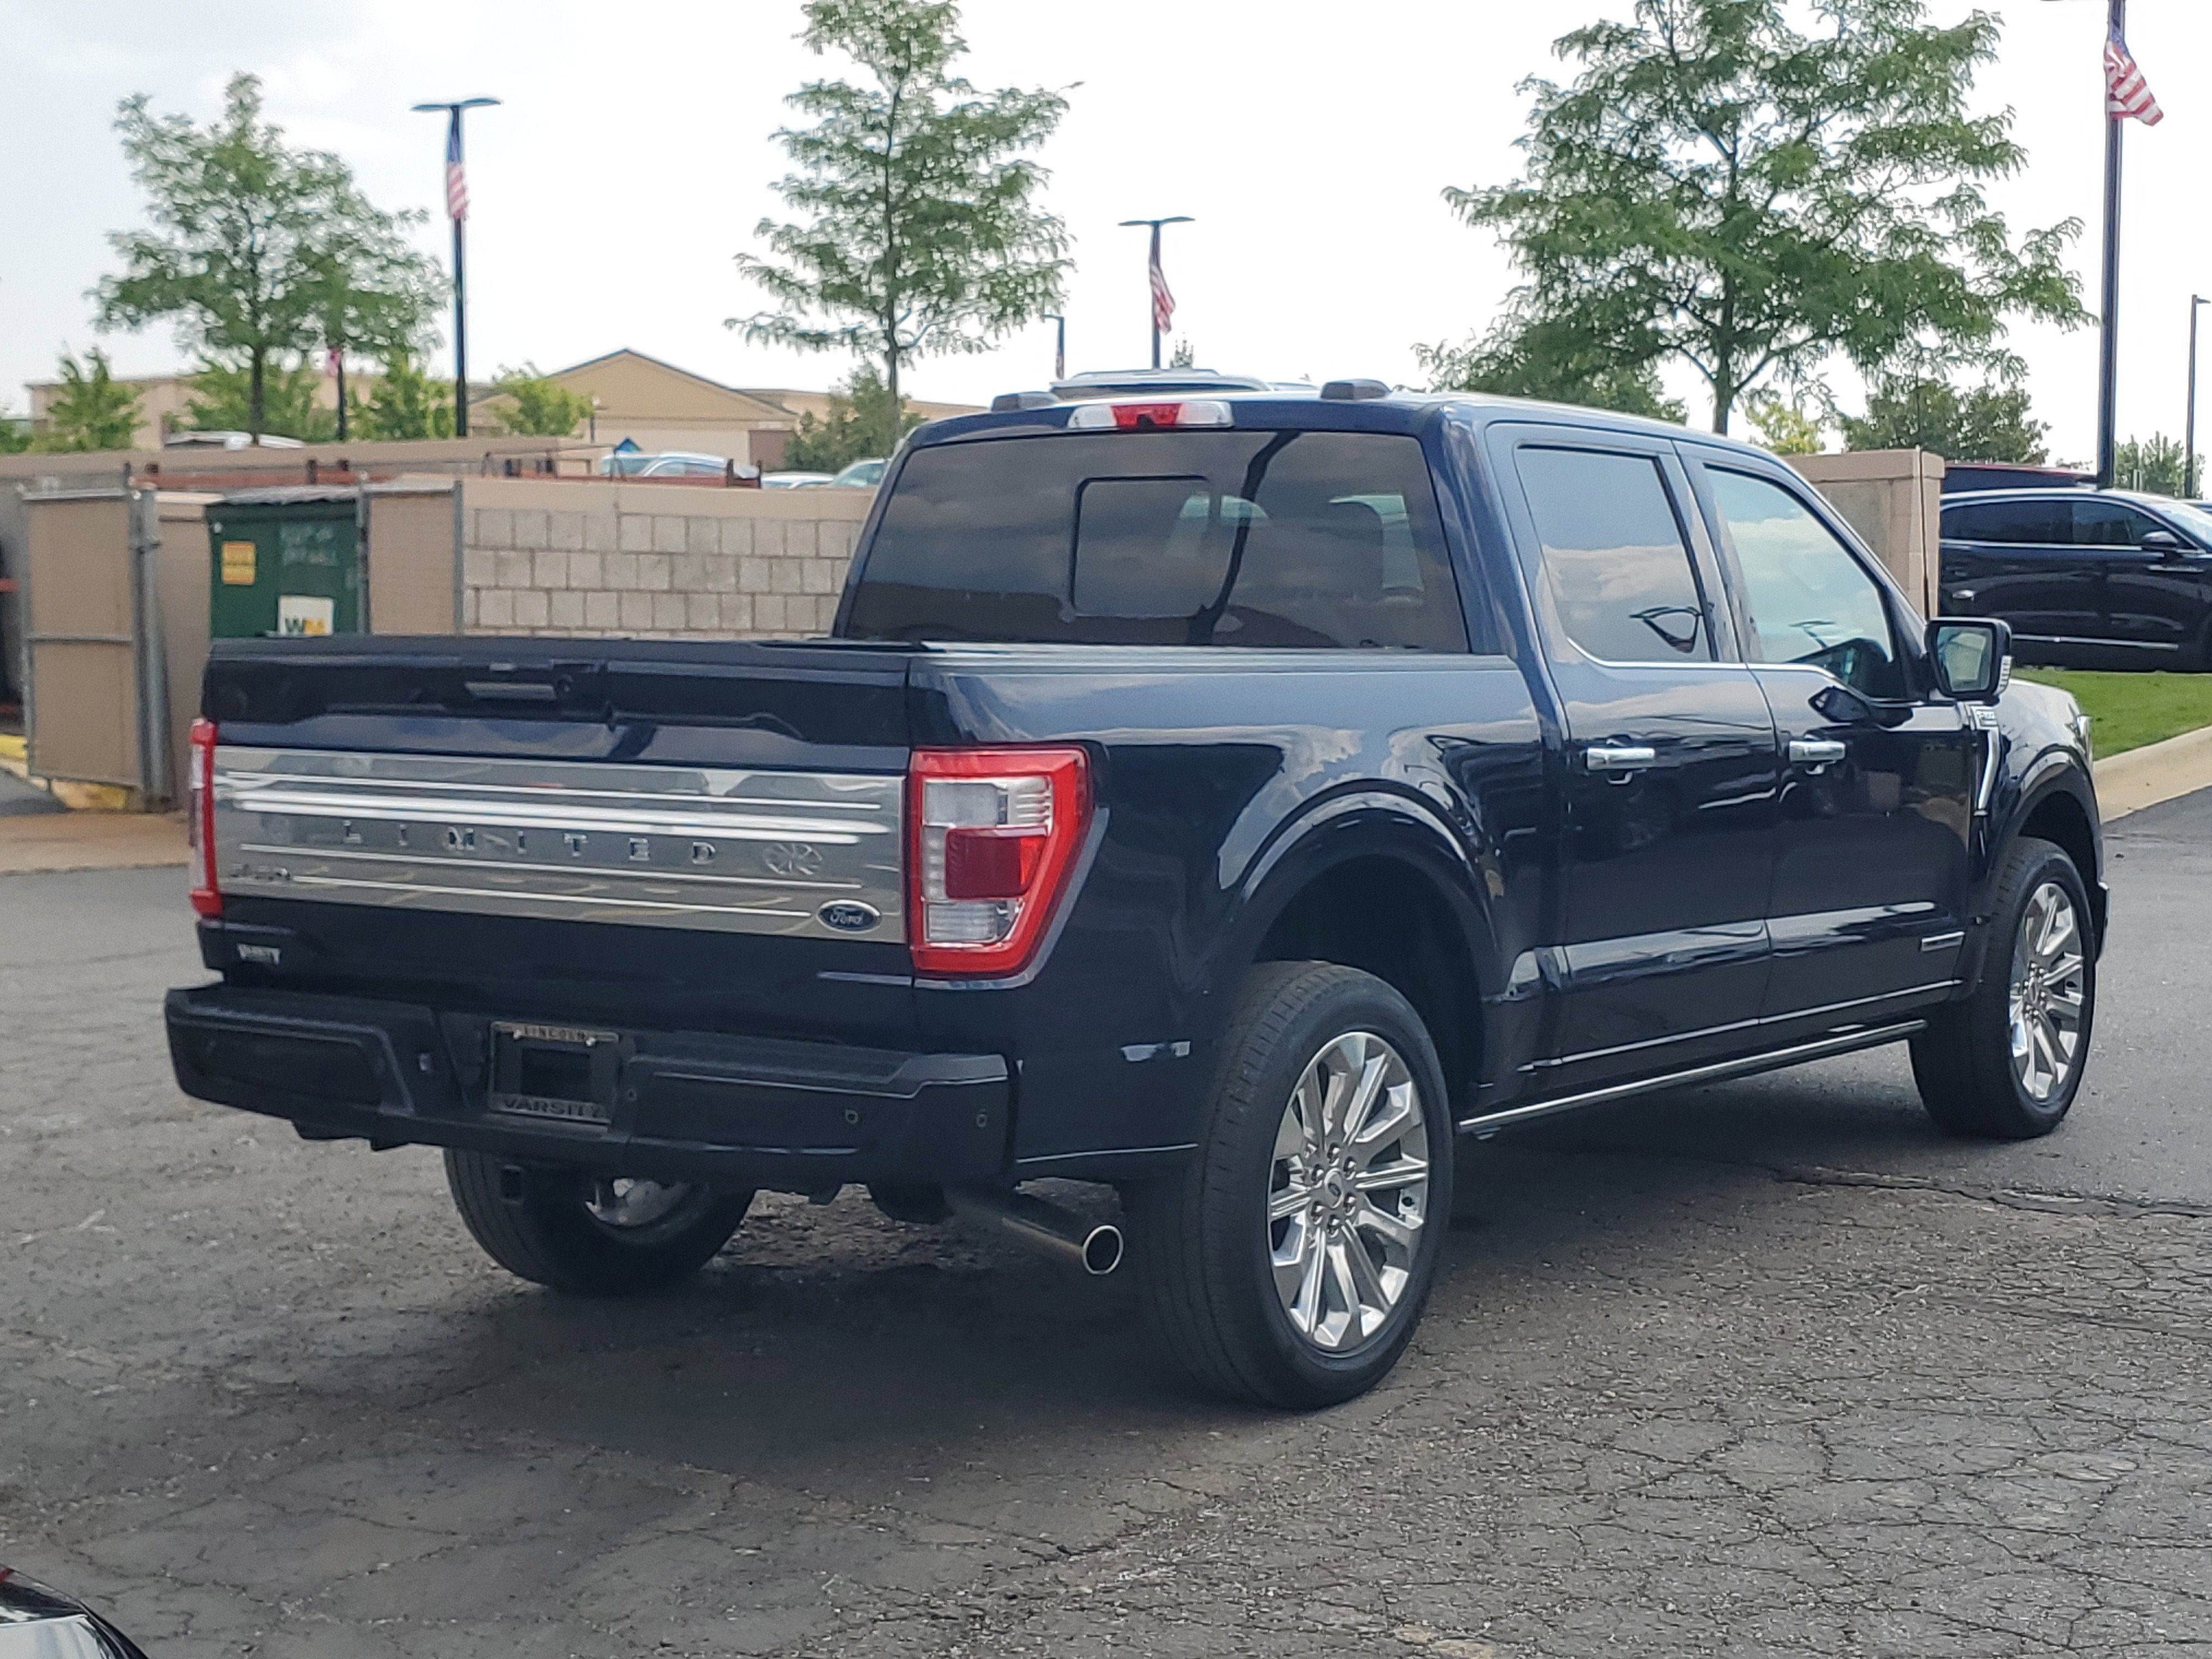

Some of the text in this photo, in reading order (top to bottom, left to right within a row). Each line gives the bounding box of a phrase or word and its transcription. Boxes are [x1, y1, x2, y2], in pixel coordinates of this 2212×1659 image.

[343, 819, 715, 865] LIMITED
[830, 906, 865, 924] Ford
[503, 1098, 601, 1118] VARSITY
